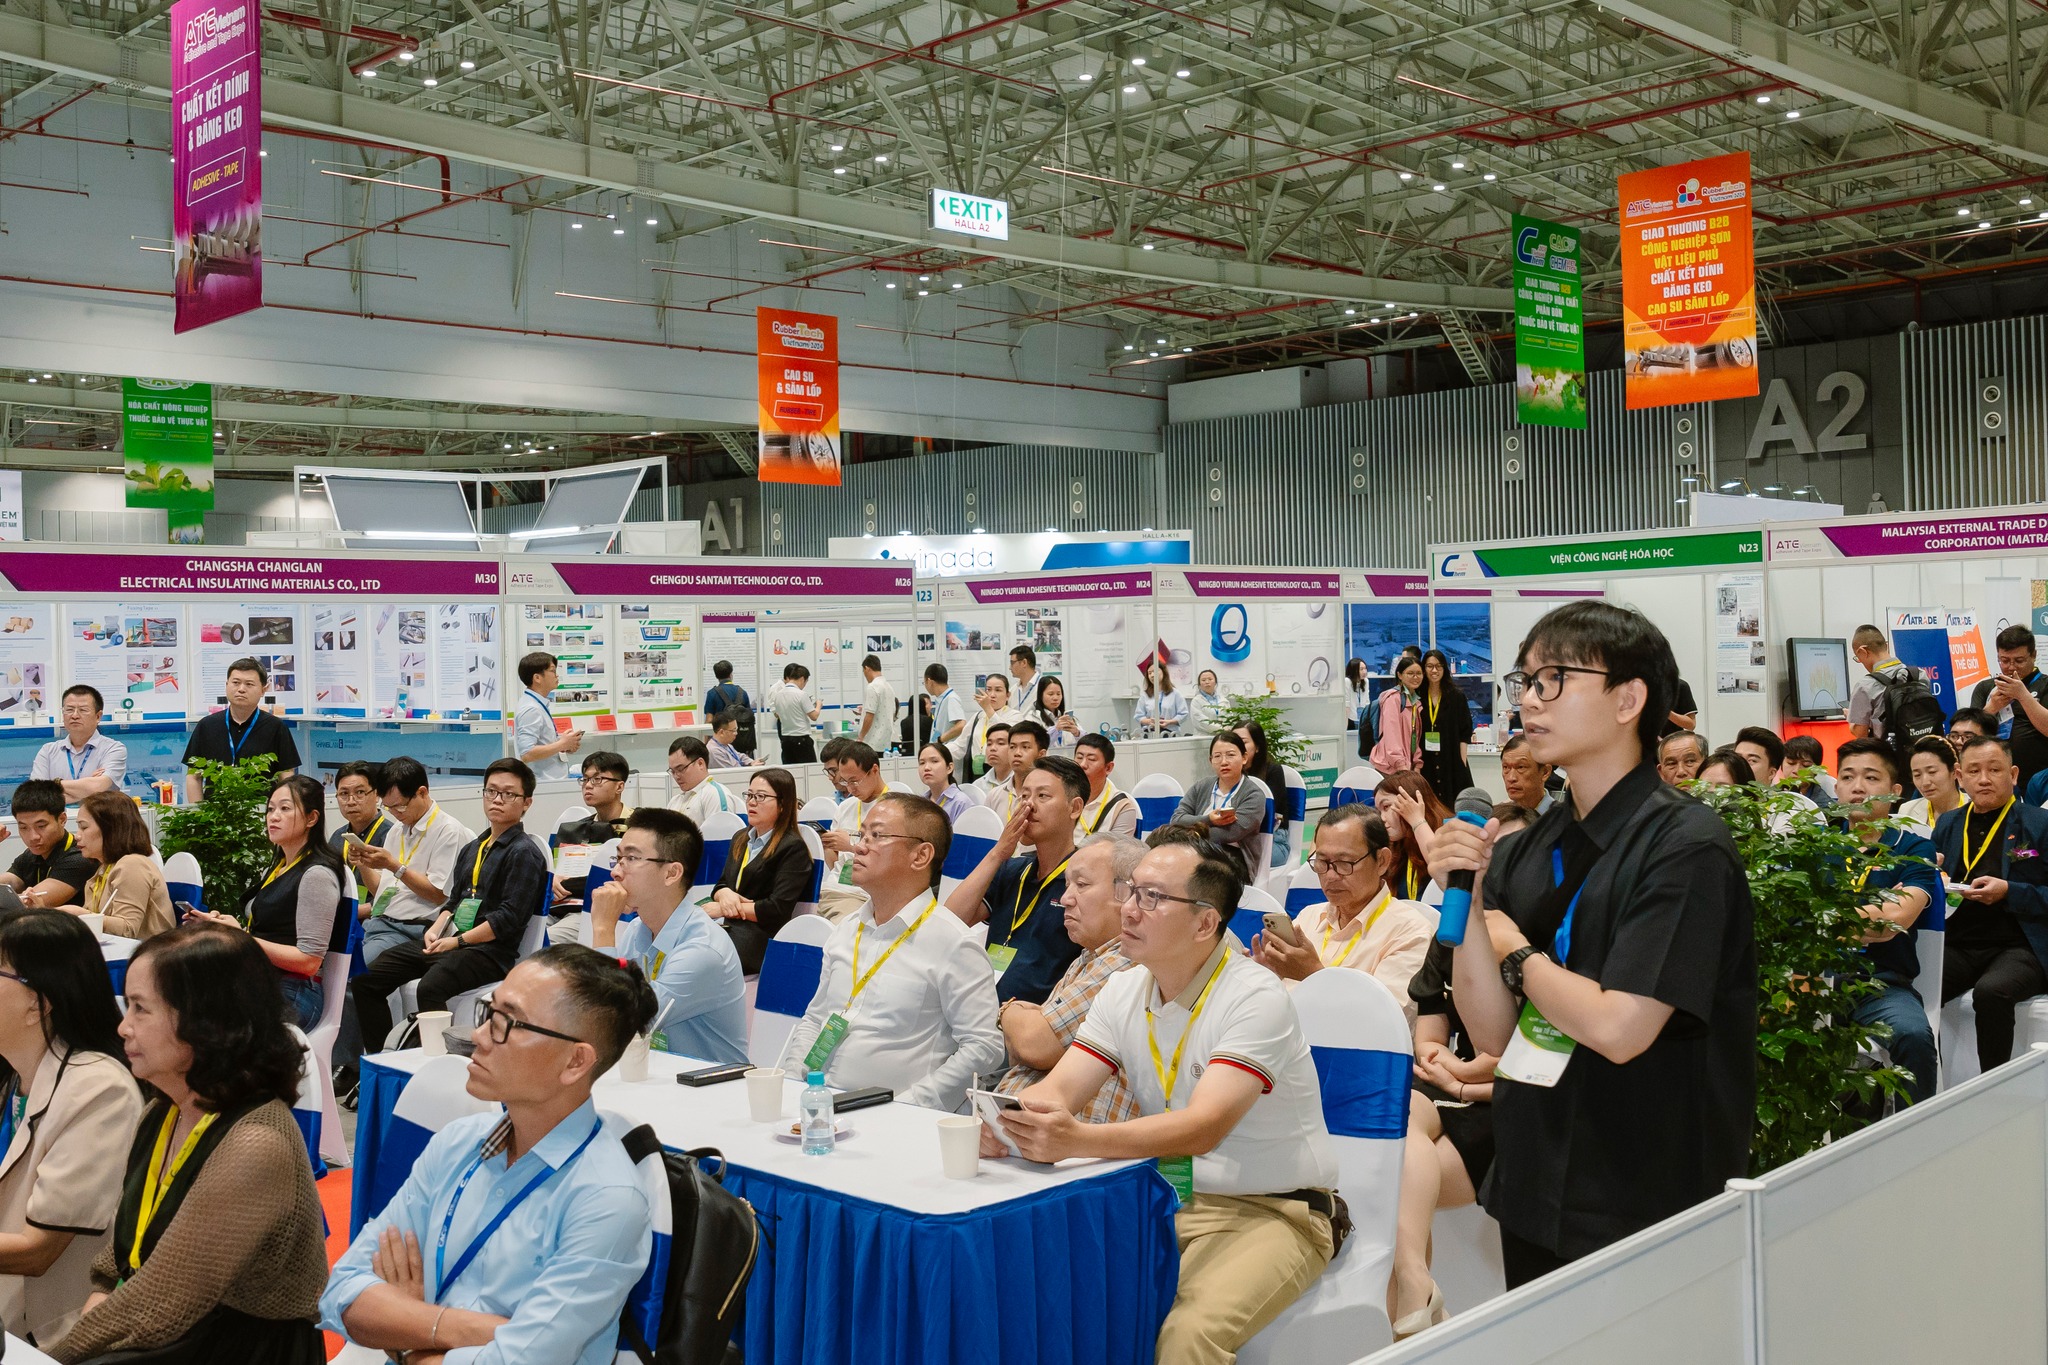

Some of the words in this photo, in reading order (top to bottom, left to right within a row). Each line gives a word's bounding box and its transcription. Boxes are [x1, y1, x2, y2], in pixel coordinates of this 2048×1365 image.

[184, 7, 216, 51] ATE
[215, 6, 246, 32] Vietnam
[217, 29, 231, 45] Tape
[182, 89, 203, 124] CHẤT
[206, 78, 222, 112] KẾT
[225, 70, 249, 103] DÍNH
[188, 130, 194, 152] &
[196, 117, 222, 147] BĂNG
[224, 105, 242, 134] KEO
[192, 168, 220, 192] ADHESIVE
[224, 161, 239, 178] TAPE
[949, 197, 993, 221] EXIT
[955, 219, 976, 230] HALL
[979, 223, 990, 232] A2
[1641, 226, 1664, 241] GIAO
[1667, 219, 1706, 237] THƯƠNG
[1709, 216, 1730, 229] B2B
[1641, 241, 1668, 256] CÔNG
[1670, 233, 1707, 251] NGHIỆP
[1710, 231, 1731, 245] SƠN
[1654, 255, 1672, 270] VẬT
[1675, 251, 1696, 267] LIỆU
[1699, 245, 1719, 262] PHỦ
[1651, 268, 1676, 285] CHẤT
[1678, 264, 1695, 281] KẾT
[1698, 262, 1724, 278] DÍNH
[1663, 283, 1690, 298] BĂNG
[1693, 280, 1712, 294] KEO
[1648, 302, 1667, 316] CAO
[1670, 300, 1682, 313] SU
[1685, 296, 1708, 310] SĂM
[1711, 291, 1730, 307] LỐP
[773, 322, 824, 339] RubberTech
[783, 337, 809, 348] Vietnam
[784, 369, 801, 381] CAO
[803, 371, 814, 382] SU
[776, 382, 783, 393] &
[785, 382, 804, 396] SĂM
[806, 383, 821, 397] LỐP
[128, 400, 142, 409] HÓA
[143, 401, 160, 411] CHẤT
[163, 403, 182, 412] NÔNG
[184, 405, 208, 414] NGHIỆP
[1745, 370, 1867, 459] A2
[129, 413, 150, 423] THUỐC
[167, 416, 176, 425] VỆ
[701, 498, 743, 551] A1
[1881, 525, 1936, 538] MALAYSIA
[1939, 521, 1996, 534] EXTERNAL
[1998, 519, 2037, 531] TRADE
[1738, 543, 1758, 554] N23
[1776, 540, 1799, 549] ATE
[1924, 536, 2005, 550] CORPORATION
[1550, 553, 1572, 566] VIỆN
[1573, 551, 1600, 563] CÔNG
[1601, 549, 1628, 562] NGHỆ
[1630, 548, 1651, 559] HÓA
[1653, 547, 1674, 560] HỌC
[186, 560, 255, 572] CHANGSHA
[257, 561, 323, 573] CHANGLAN
[120, 577, 194, 589] ELECTRICAL
[197, 578, 268, 590] INSULATING
[271, 578, 335, 590] MATERIALS
[337, 579, 358, 592] CO.,
[361, 580, 381, 591] LTD
[475, 573, 497, 584] M30
[511, 574, 533, 583] ATE
[650, 575, 694, 585] CHENGDU
[695, 576, 732, 586] SANTAM
[733, 576, 789, 587] TECHNOLOGY
[790, 577, 806, 587] CO.,
[807, 577, 824, 586] LTD.
[895, 578, 912, 587] M26
[1198, 580, 1220, 589] NINGBO
[1221, 581, 1240, 589] YURUN
[1240, 581, 1267, 589] ADHESIVE
[1267, 581, 1300, 589] TECHNOLOGY
[1328, 581, 1339, 589] M24
[980, 588, 1004, 596] NINGBO
[1005, 587, 1025, 595] YURUN
[1026, 585, 1056, 594] ADHESIVE
[1057, 583, 1099, 592] TECHNOLOGY
[1113, 581, 1127, 590] LTD.
[1136, 581, 1151, 589] M24
[1897, 613, 1937, 625] MATRADE
[1945, 613, 1971, 626] MATRADE
[1909, 725, 1934, 736] Bonny
